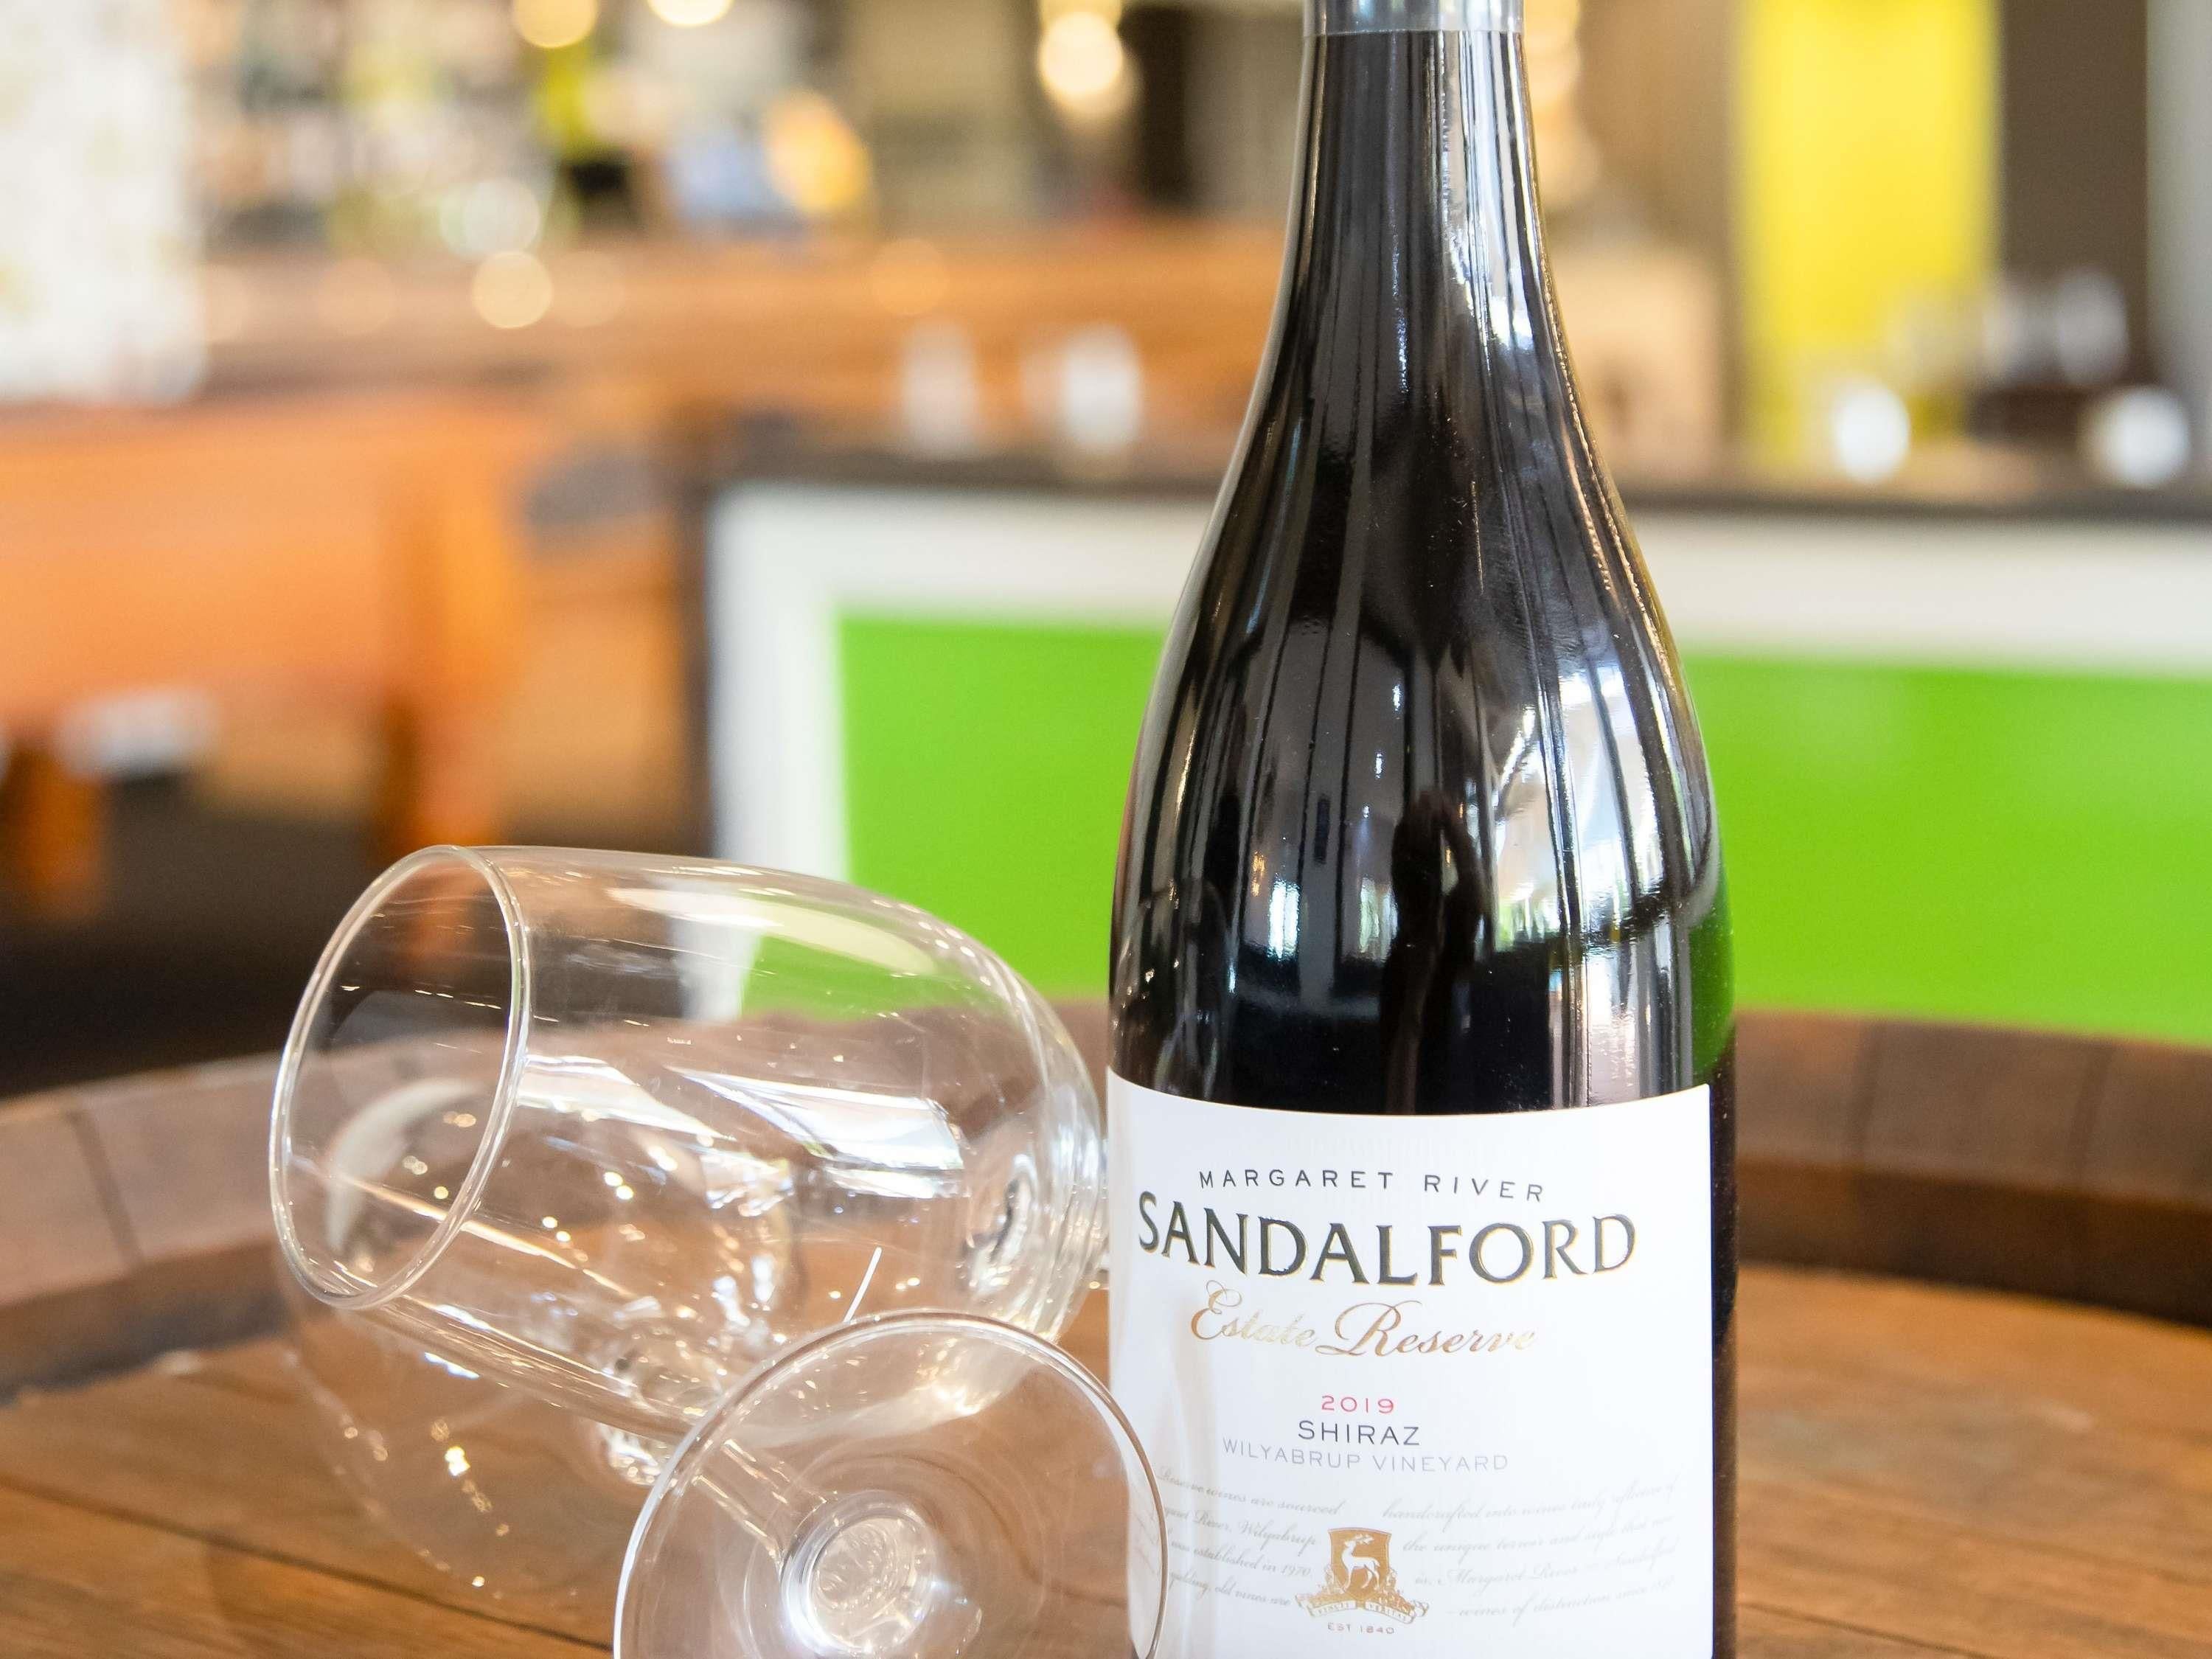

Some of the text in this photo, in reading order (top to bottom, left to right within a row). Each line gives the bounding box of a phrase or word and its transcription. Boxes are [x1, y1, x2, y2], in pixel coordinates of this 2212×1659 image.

[1199, 1169, 1544, 1203] MARGARET RIVER
[1138, 1190, 1637, 1287] SANDALFORD
[1191, 1280, 1538, 1357] Estate Reserve
[1321, 1395, 1395, 1413] 2019
[1298, 1420, 1420, 1446] SHIRAZ
[1222, 1437, 1509, 1472] WILYABRUP VINEYARD
[1327, 1622, 1395, 1635] EST 1840
